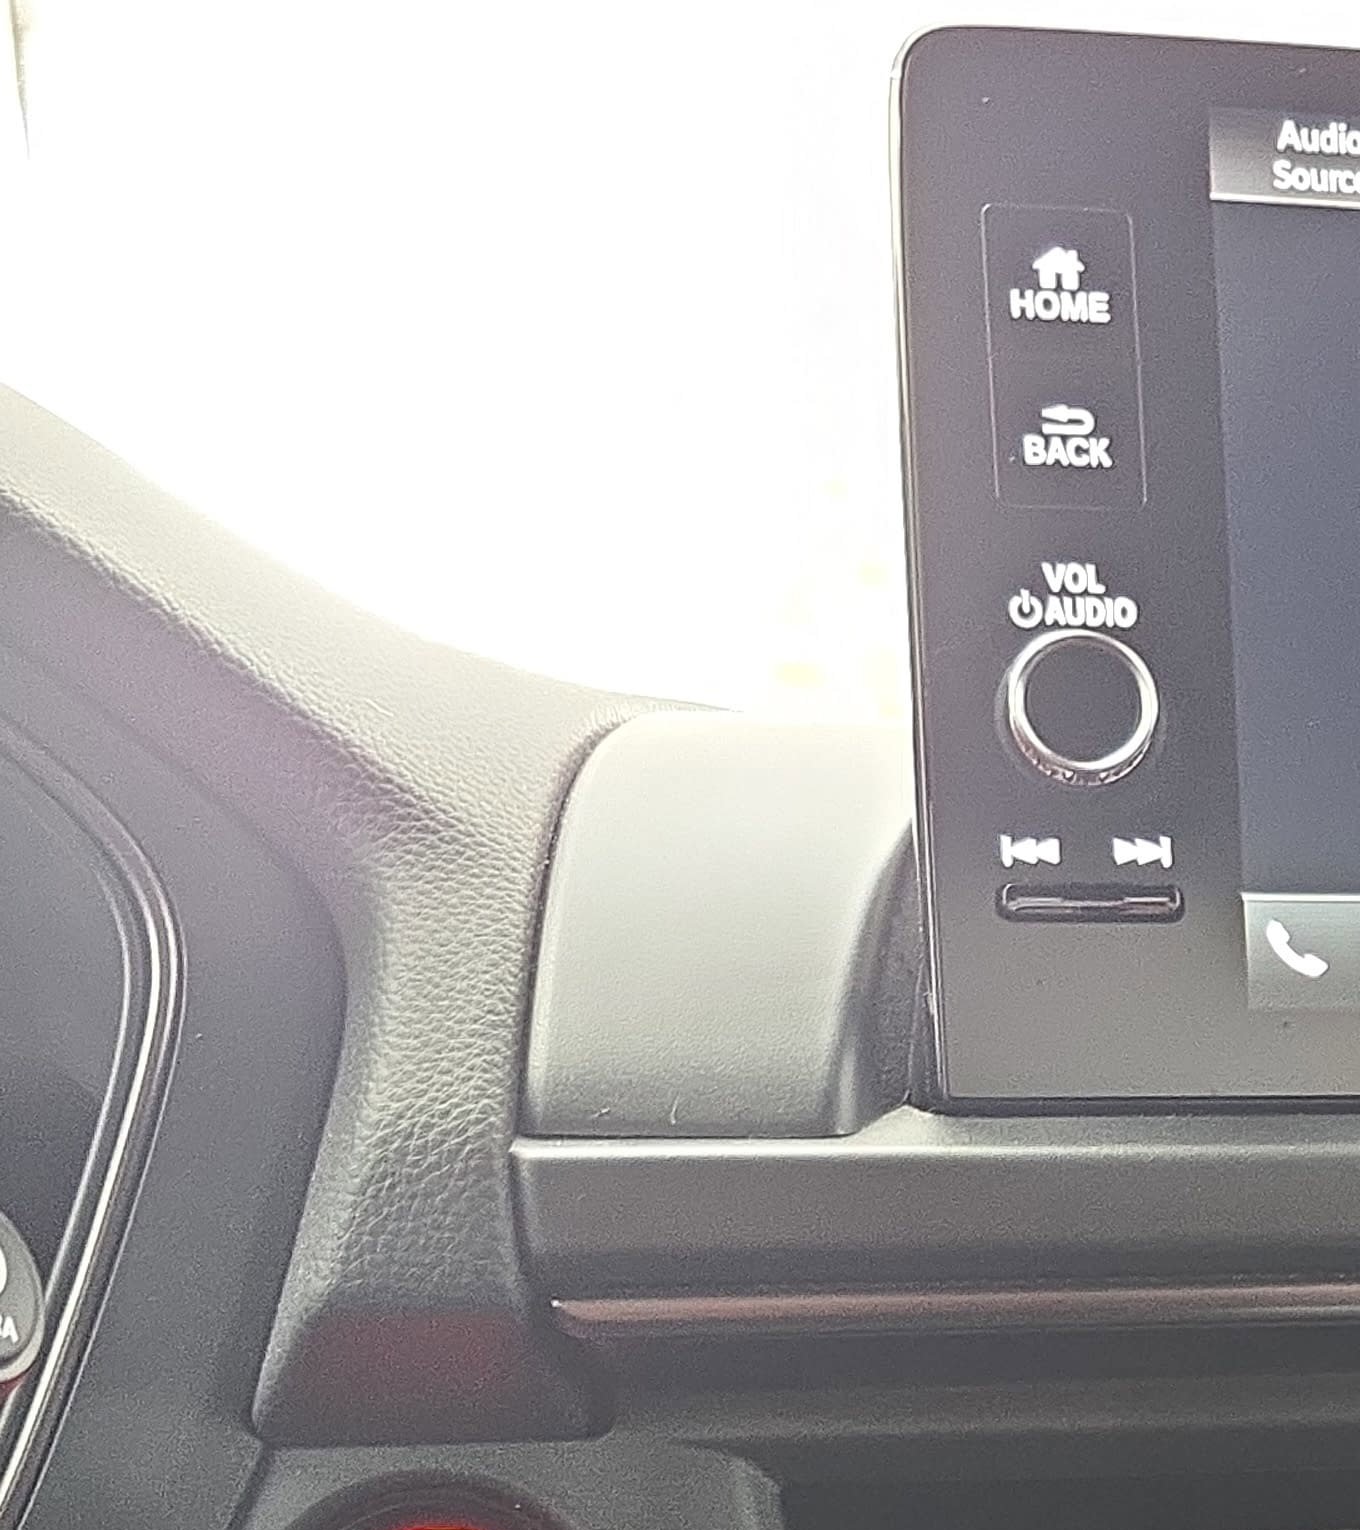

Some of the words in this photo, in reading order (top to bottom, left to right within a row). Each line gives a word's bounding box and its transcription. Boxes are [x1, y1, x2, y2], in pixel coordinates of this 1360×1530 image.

[1010, 287, 1110, 324] HOME
[1023, 436, 1113, 469] BACK
[1041, 563, 1106, 595] VOL
[1044, 596, 1138, 629] AUDIO
